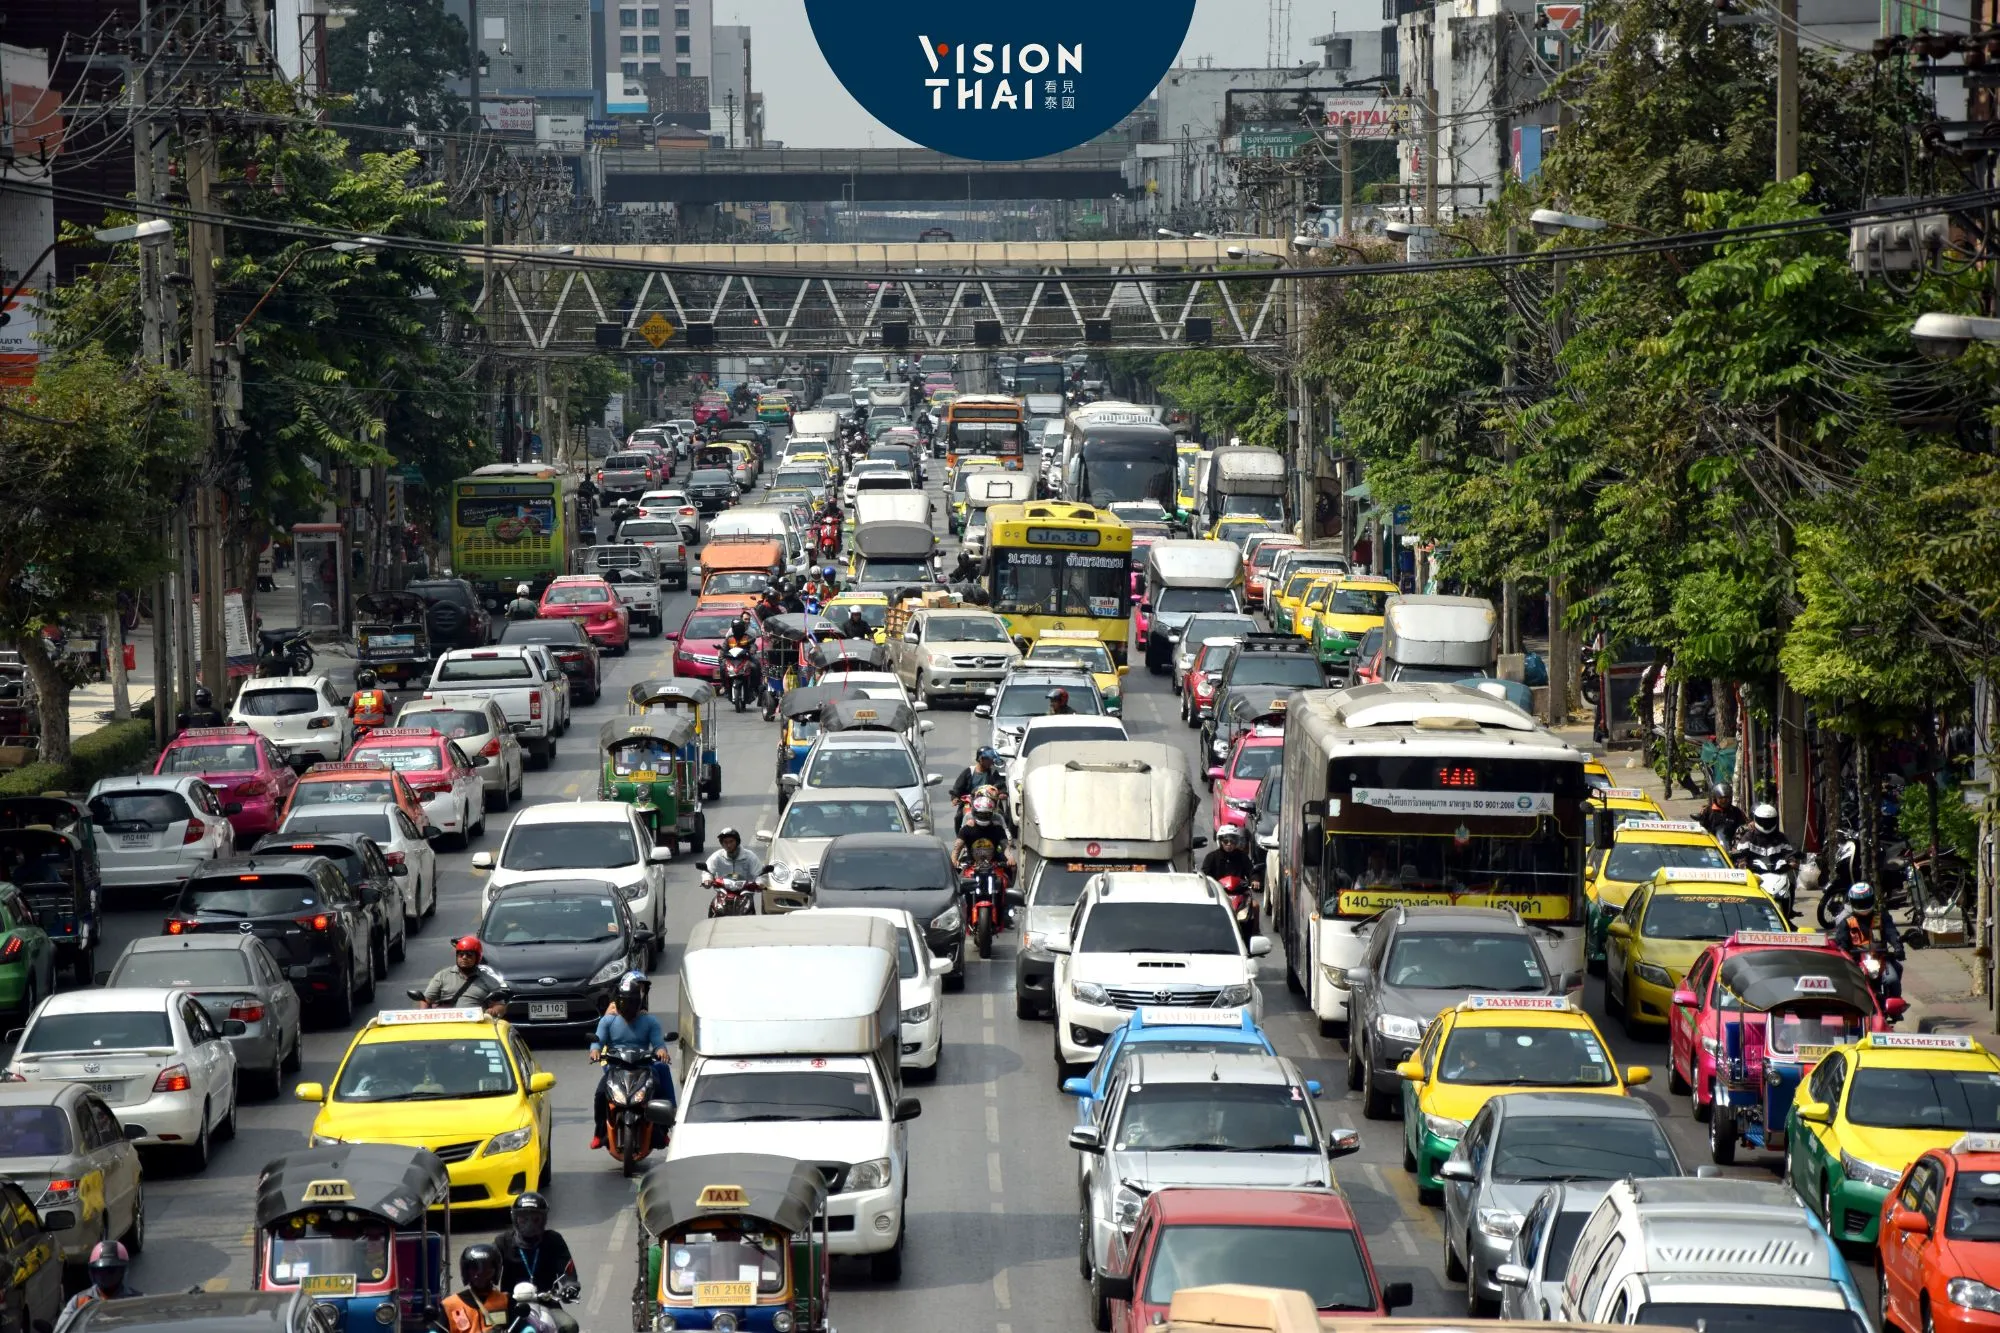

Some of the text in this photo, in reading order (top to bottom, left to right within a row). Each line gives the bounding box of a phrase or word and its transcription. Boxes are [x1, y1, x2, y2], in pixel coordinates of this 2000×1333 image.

[1327, 111, 1389, 126] DIGITAL
[1440, 768, 1475, 785] 140
[1473, 800, 1483, 809] ISO
[1485, 801, 1515, 810] 9001:2008
[1344, 896, 1369, 908] 140
[1748, 933, 1810, 944] TAXI-METER
[1803, 979, 1829, 989] TAXI
[1486, 998, 1553, 1008] TAXI-METER
[546, 1004, 564, 1013] 1102
[396, 1011, 464, 1021] TAXI-METER
[1888, 1037, 1956, 1047] TAXI-METER
[314, 1184, 345, 1196] TAXI
[708, 1190, 739, 1202] TAXI
[725, 1285, 751, 1295] 2109
